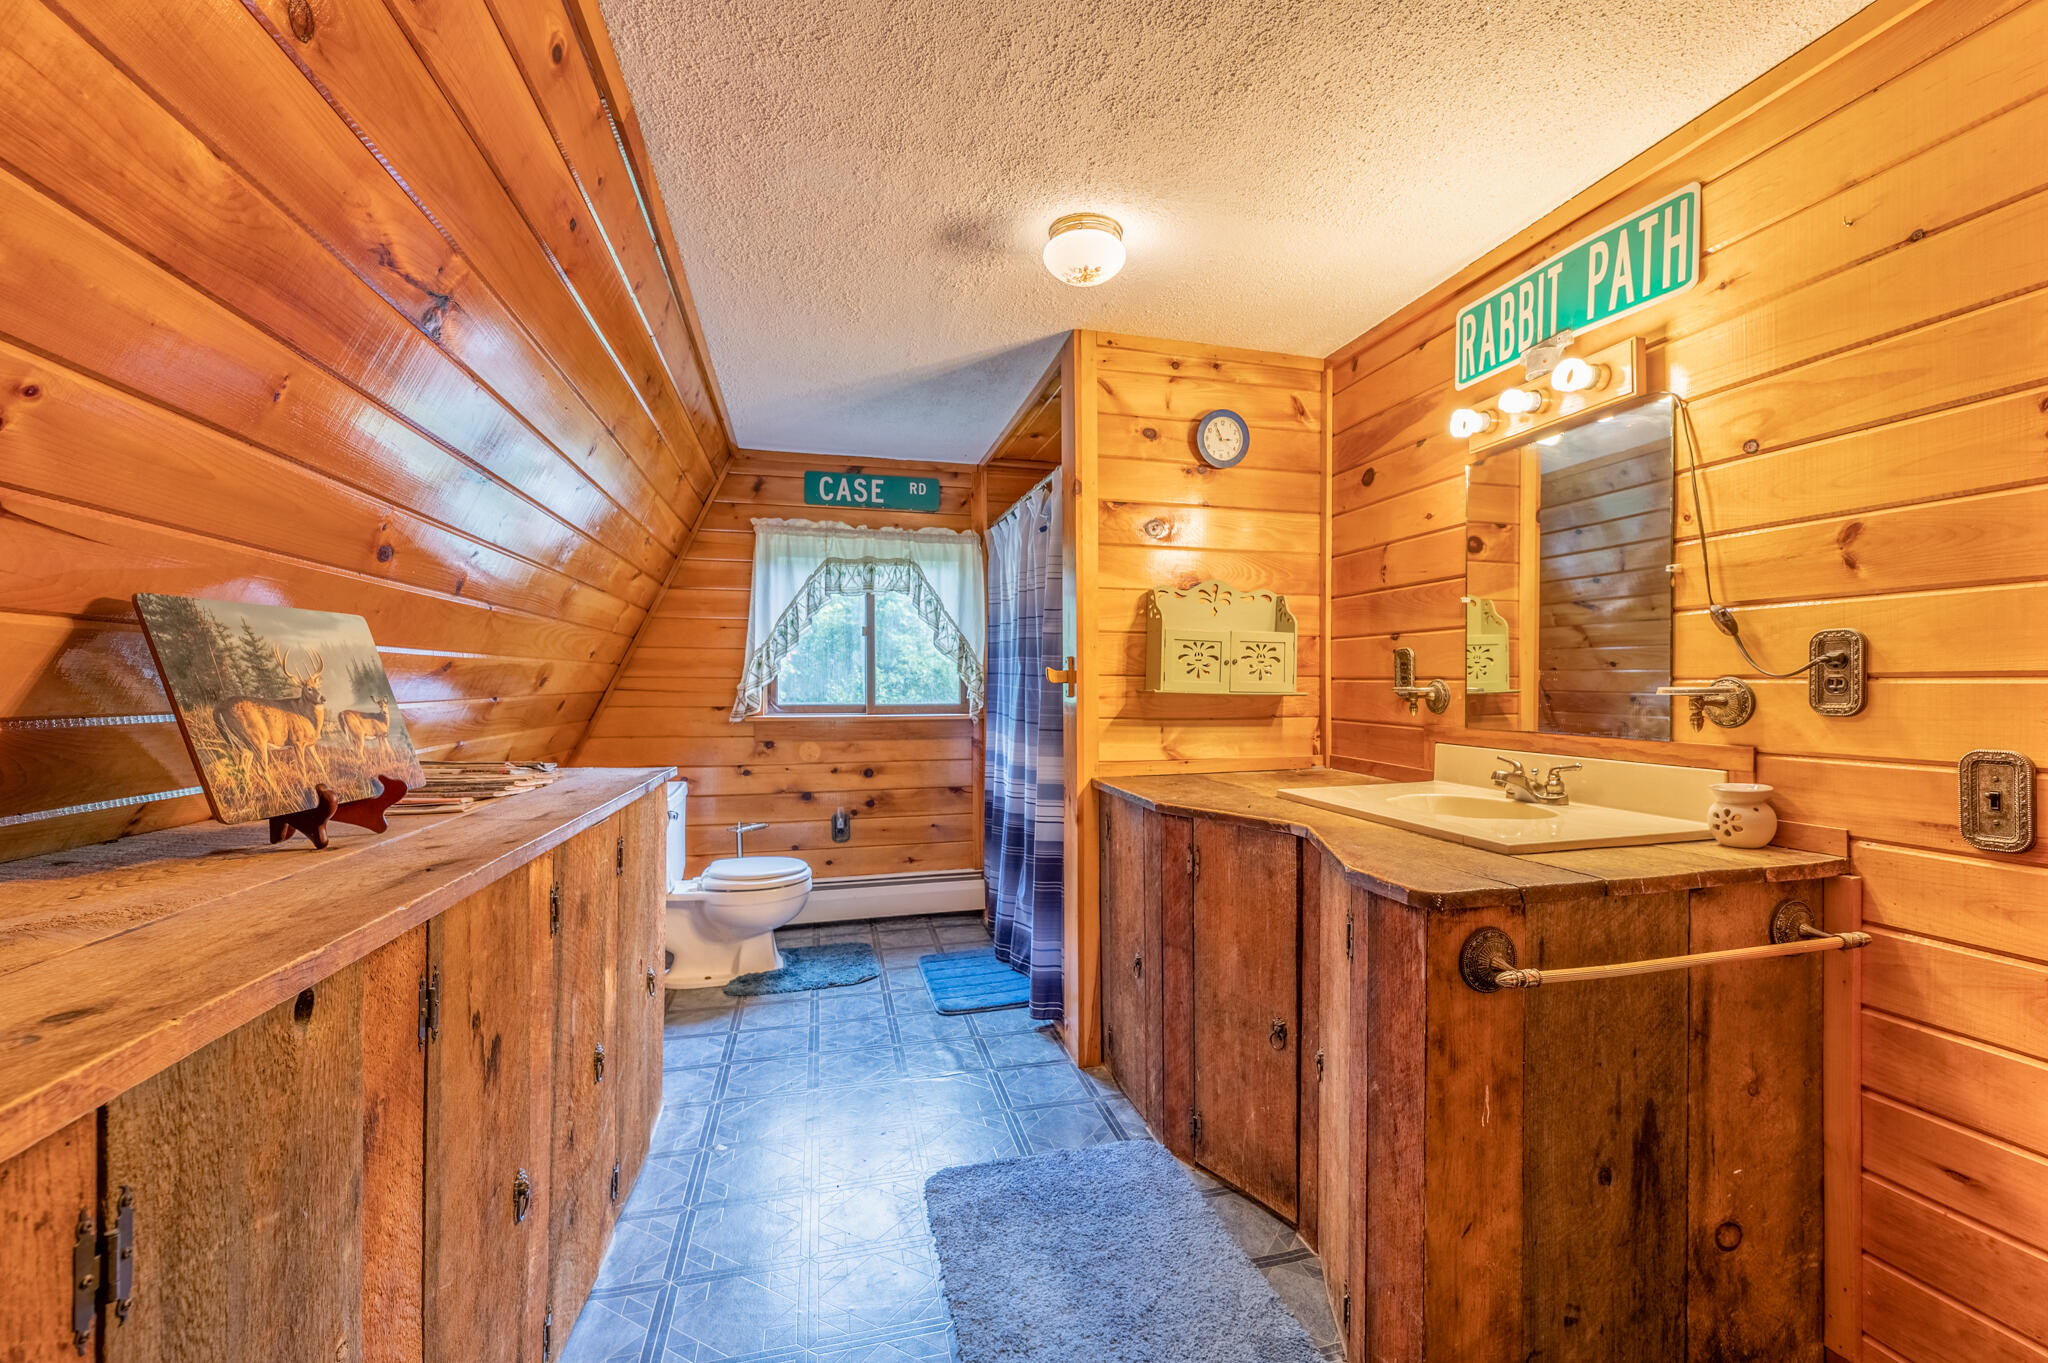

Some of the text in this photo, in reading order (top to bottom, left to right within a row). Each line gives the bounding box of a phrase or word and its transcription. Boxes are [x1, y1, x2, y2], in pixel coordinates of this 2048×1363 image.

[1461, 197, 1689, 381] RABBIT PATH
[819, 476, 927, 503] CASE RD
